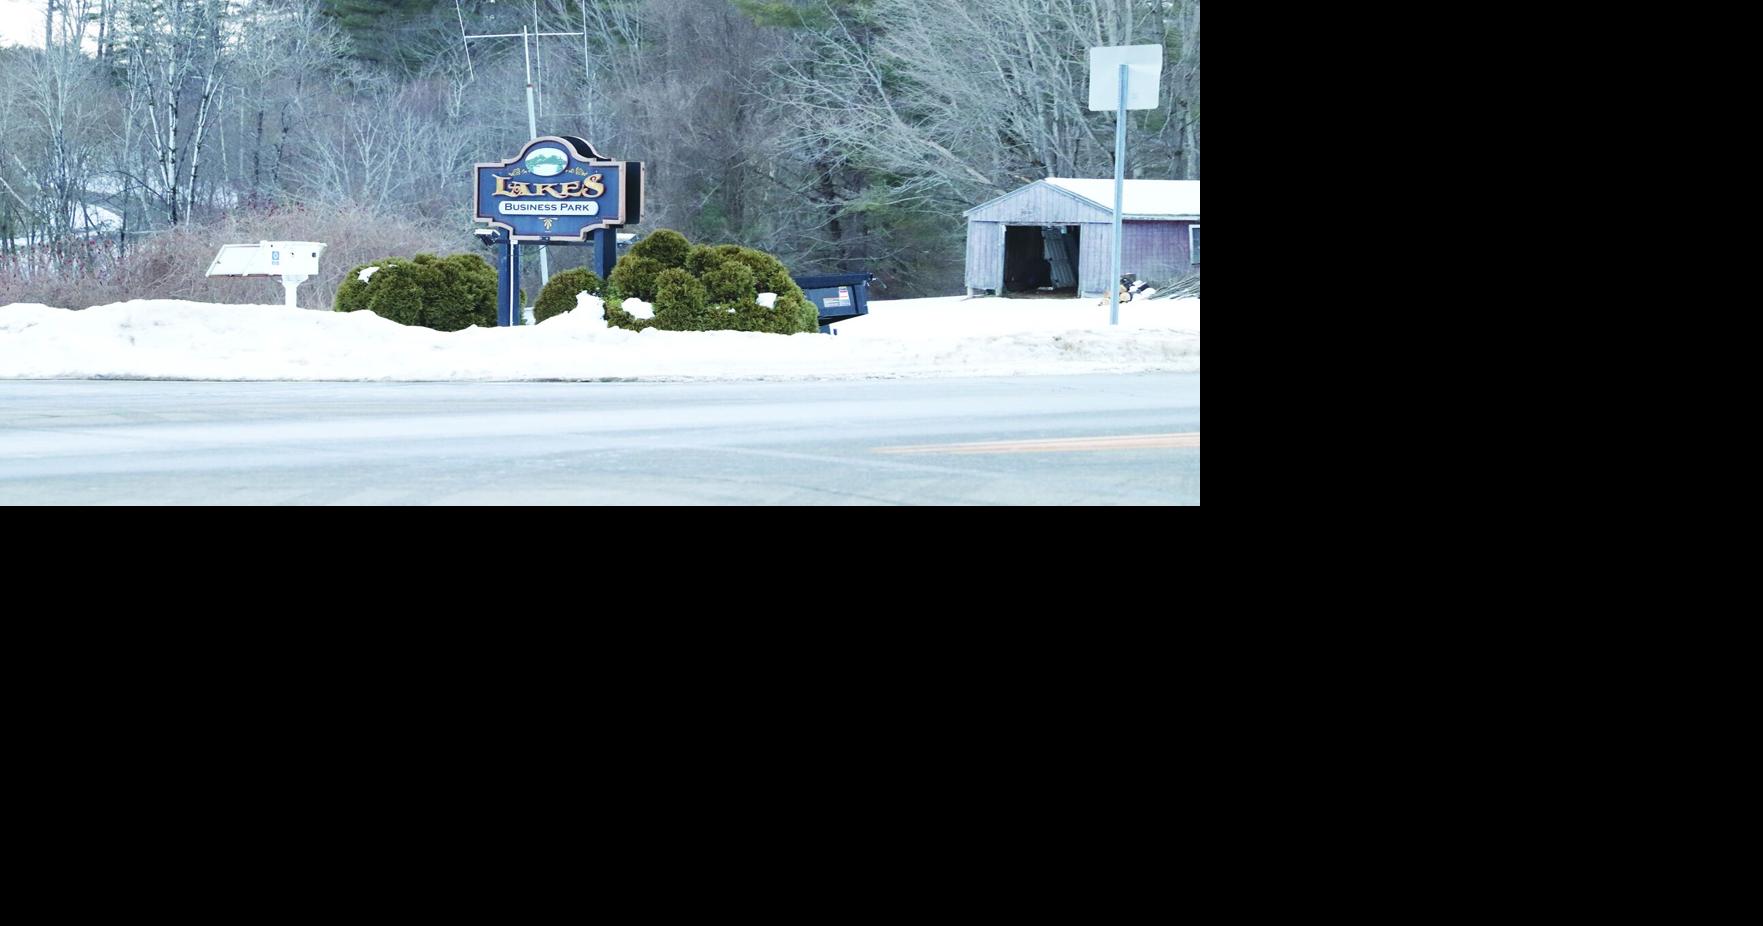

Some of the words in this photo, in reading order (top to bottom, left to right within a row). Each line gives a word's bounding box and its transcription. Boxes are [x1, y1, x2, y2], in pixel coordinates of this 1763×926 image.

[492, 174, 605, 199] LAKES
[504, 203, 558, 211] BUSINESS
[560, 203, 590, 211] PARK
